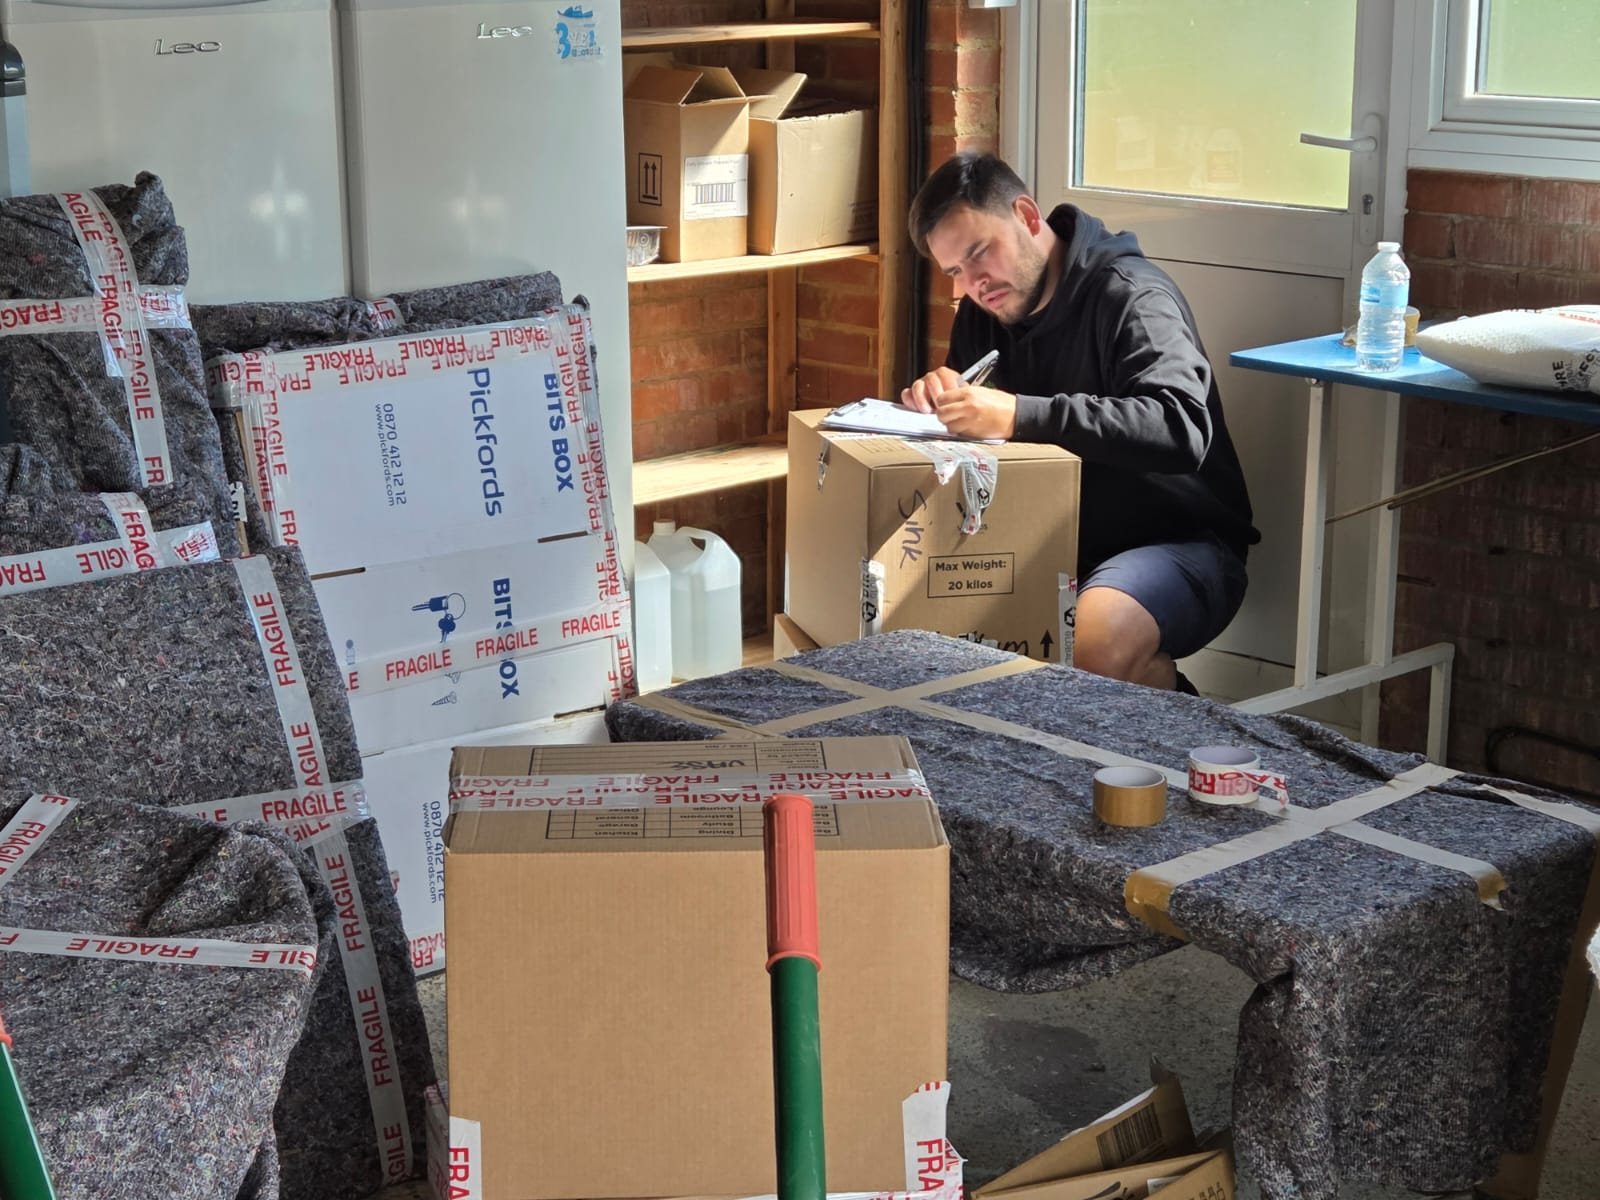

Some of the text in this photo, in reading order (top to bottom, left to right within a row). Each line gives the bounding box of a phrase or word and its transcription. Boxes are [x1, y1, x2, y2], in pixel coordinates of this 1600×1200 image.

[61, 192, 103, 242] AGILE
[0, 301, 63, 329] FRAG
[128, 329, 155, 421] FRAGILE
[210, 325, 546, 386] GILE FRAGILE FRAGILE RAGILE
[241, 350, 265, 394] GILE
[556, 344, 583, 424] FRAGILE
[375, 403, 395, 507] www.pickfords.com
[383, 403, 407, 505] 0870 412 12 12
[467, 367, 505, 517] Pickfords
[544, 373, 575, 493] BITS BOX
[567, 313, 593, 392] FRAGILE
[586, 421, 608, 500] FRAGILE
[603, 529, 619, 597] RAGILE
[76, 547, 130, 574] GILE
[122, 511, 155, 572] FRAG
[935, 559, 1007, 572] Max Weight:
[948, 579, 993, 591] 20 kilos
[386, 610, 621, 681] FRAGILE FRAGILE FRAGILE
[253, 591, 297, 687] FRAGILE
[291, 721, 324, 788] AGILE
[500, 658, 520, 700] OX
[598, 774, 720, 786] FRAGILE
[769, 771, 893, 782] FRAGILE
[830, 787, 932, 800] RAGILE
[262, 790, 347, 823] FRAGILE
[430, 800, 443, 838] 0870
[479, 796, 603, 808] FRAGILE
[423, 802, 437, 904] www.pickfords.com
[66, 937, 318, 970] GILE FRAGILE
[324, 852, 406, 1185] FRAGILE FRAGILE GILE
